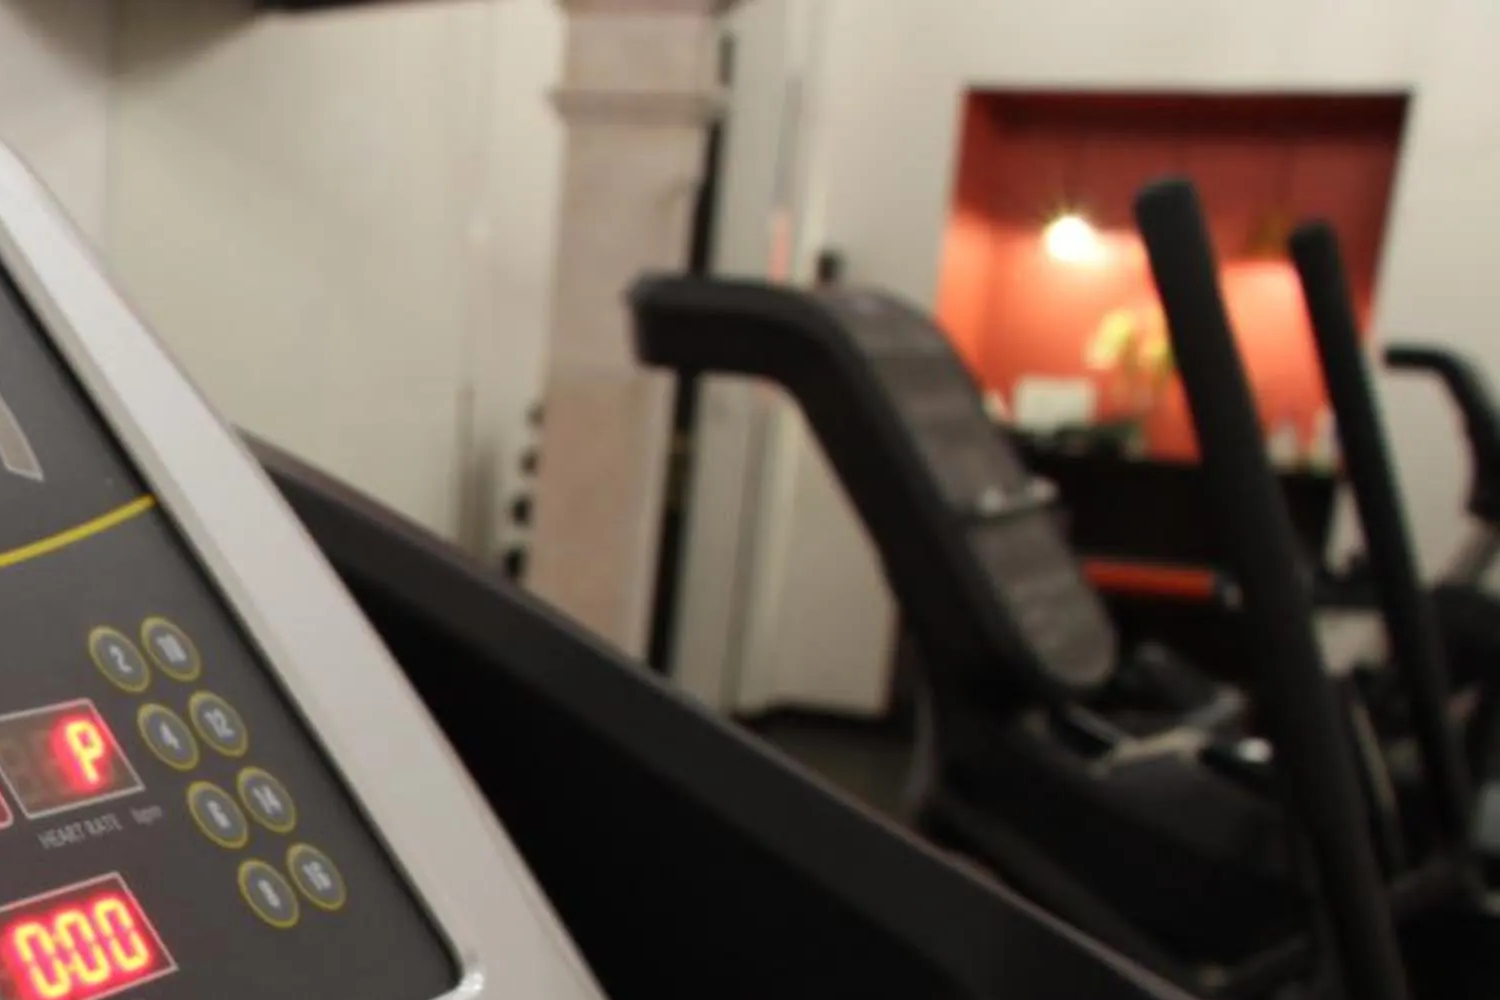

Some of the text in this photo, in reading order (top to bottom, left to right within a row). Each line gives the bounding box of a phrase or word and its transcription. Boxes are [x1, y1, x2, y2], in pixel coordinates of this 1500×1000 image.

[108, 644, 133, 674] 2
[63, 718, 105, 785] P
[37, 821, 86, 851] HEART
[83, 813, 123, 836] RATE
